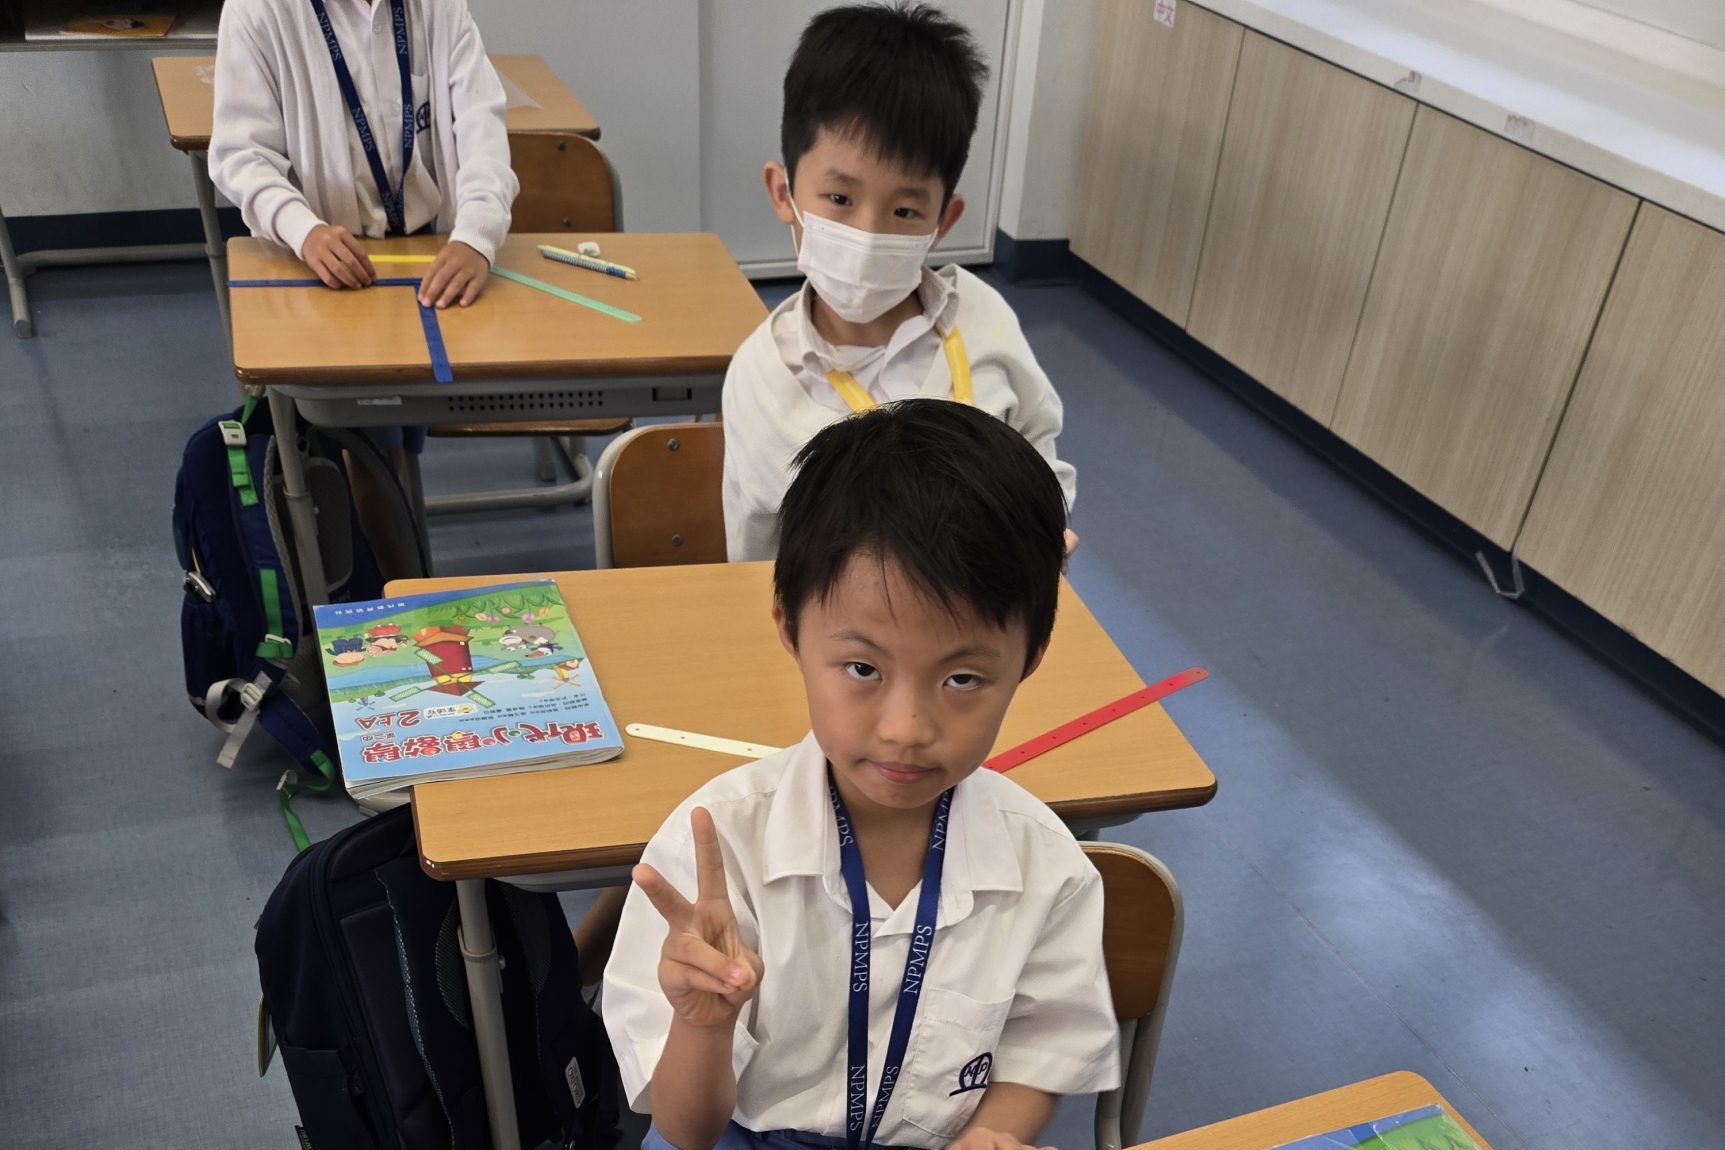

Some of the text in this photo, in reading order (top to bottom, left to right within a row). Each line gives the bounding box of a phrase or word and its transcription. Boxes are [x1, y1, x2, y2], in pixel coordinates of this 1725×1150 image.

[317, 12, 342, 61] NPMPS
[393, 7, 407, 55] NPMPS
[352, 107, 375, 152] NPMPS
[404, 103, 414, 148] NPMPS
[356, 708, 422, 731] 2上A
[362, 720, 604, 764] 現代小學數學
[853, 922, 869, 992] NPMPS
[903, 924, 932, 994] NPMPS
[850, 1065, 865, 1131] NPMPS
[871, 1065, 899, 1129] NPMPS
